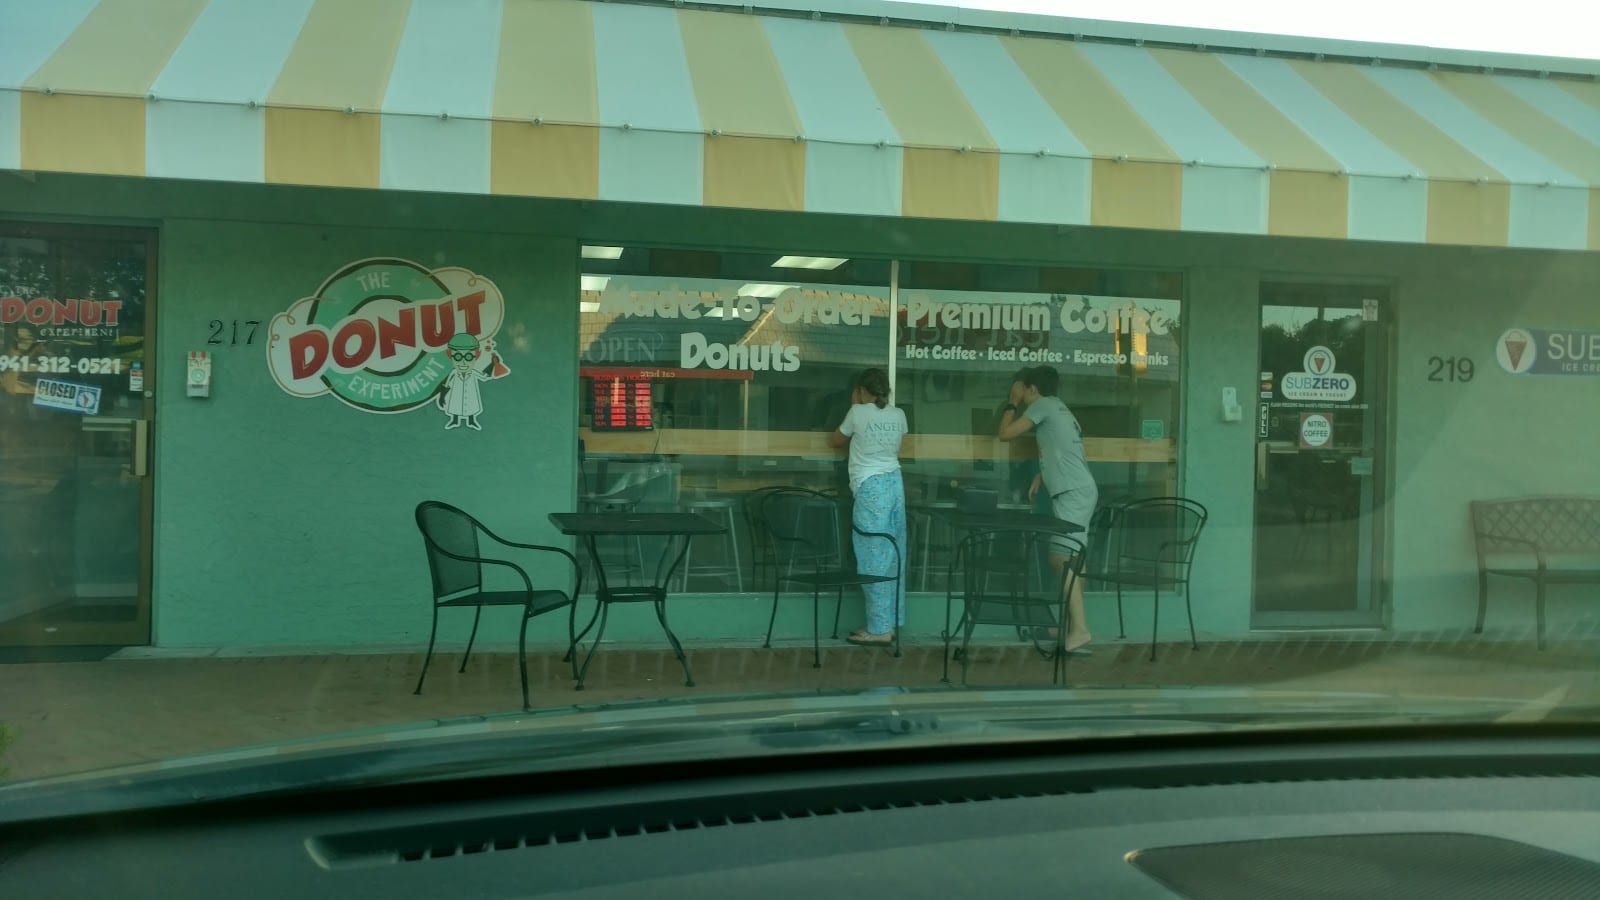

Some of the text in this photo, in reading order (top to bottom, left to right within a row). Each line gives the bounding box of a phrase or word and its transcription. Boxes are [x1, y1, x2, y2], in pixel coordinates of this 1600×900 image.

[356, 271, 391, 292] THE
[0, 296, 122, 326] DONUT
[906, 292, 1169, 335] Premium Coffee
[207, 320, 262, 345] 217
[289, 290, 486, 380] DONUT
[587, 337, 655, 363] OPEN
[680, 332, 800, 371] Donuts
[906, 345, 929, 359] Hot
[932, 345, 976, 360] Coffee
[988, 347, 1015, 361] Iced
[1018, 347, 1062, 363] Coffee
[1074, 350, 1127, 365] Espresso
[0, 355, 120, 374] 941-312-0521
[1428, 356, 1475, 382] 219
[1562, 363, 1579, 371] ICE
[38, 380, 77, 399] CLOSED
[347, 357, 445, 399] EXPERIMENT
[1286, 377, 1349, 390] SUBZERO
[1307, 420, 1327, 428] NITRO
